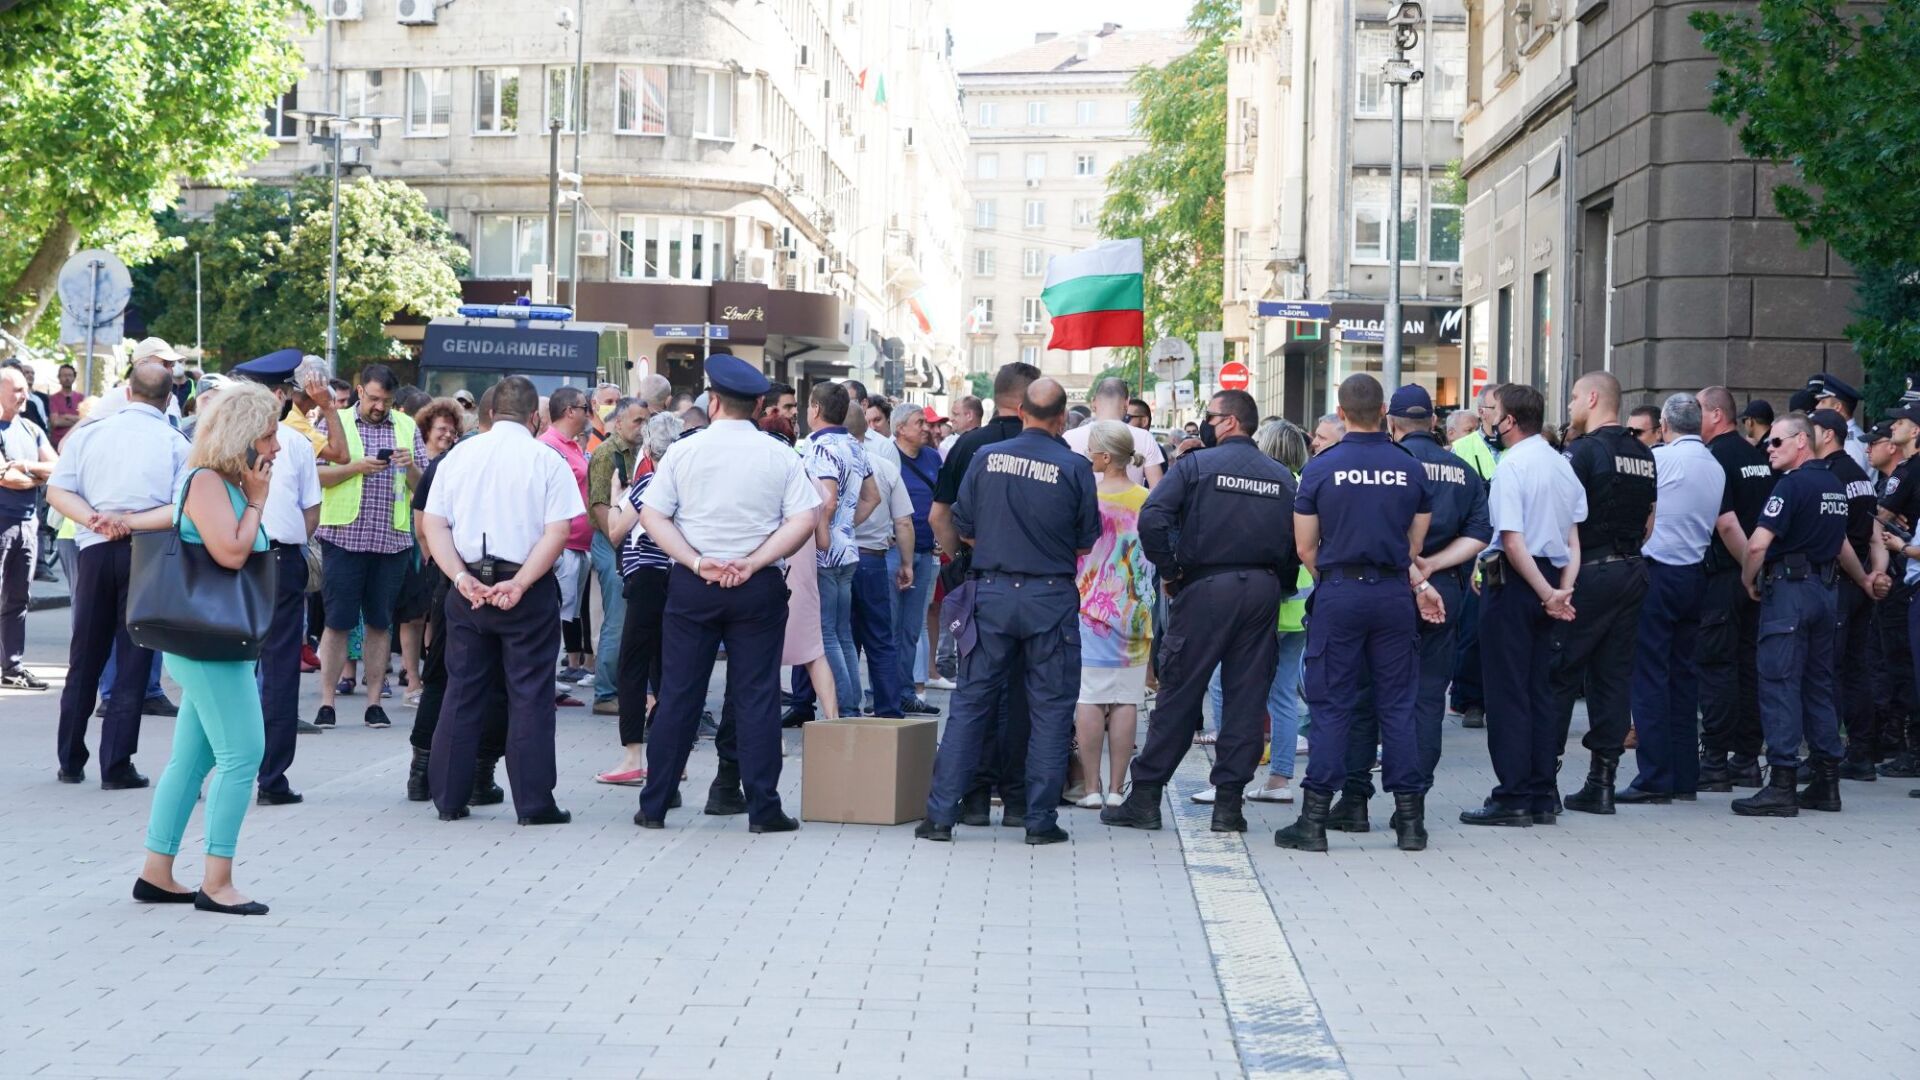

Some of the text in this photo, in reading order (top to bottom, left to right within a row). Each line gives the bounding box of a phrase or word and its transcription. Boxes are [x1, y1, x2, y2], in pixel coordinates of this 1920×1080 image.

[1339, 319, 1425, 334] BULGAAN
[442, 339, 579, 358] GENDARMERIE
[986, 453, 1060, 485] SECURITY POLICE
[1440, 464, 1466, 486] POLICE
[1615, 456, 1655, 478] POLICE
[1216, 475, 1280, 495] ПОЛИЦИЯ
[1334, 469, 1408, 487] POLICE
